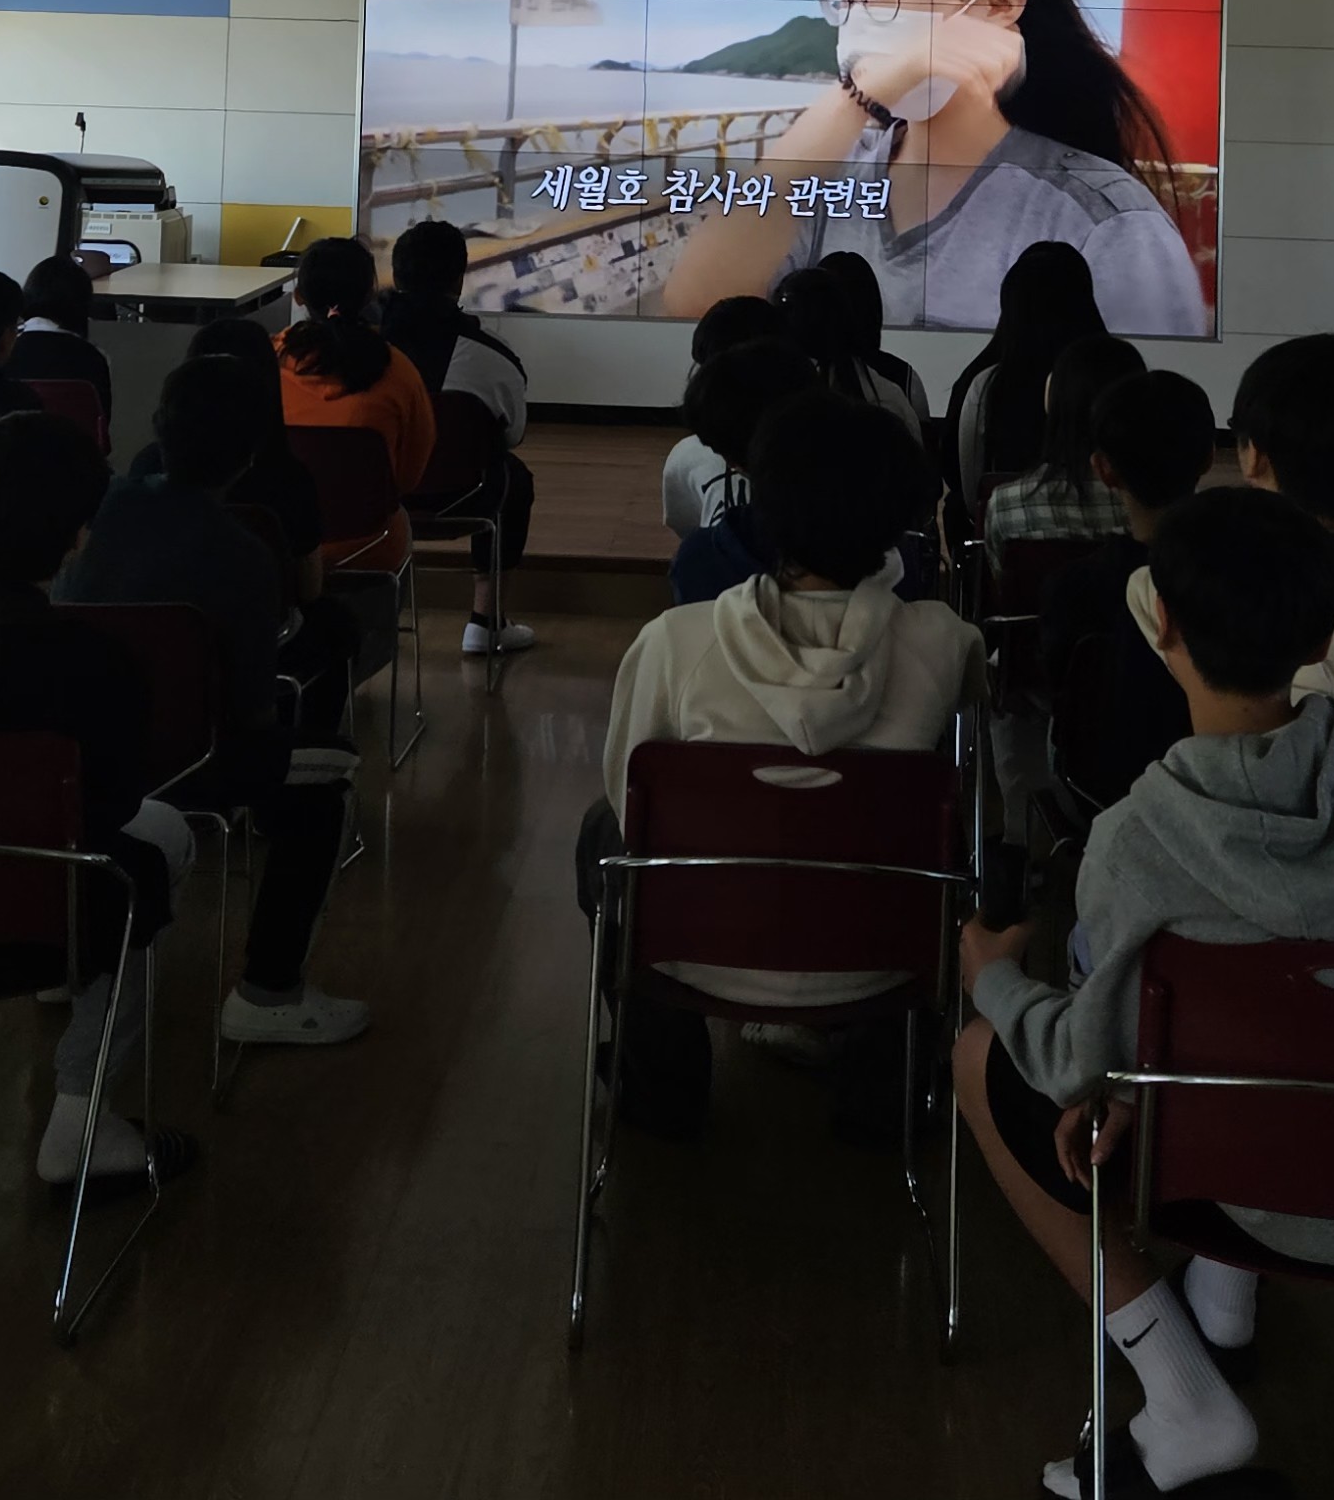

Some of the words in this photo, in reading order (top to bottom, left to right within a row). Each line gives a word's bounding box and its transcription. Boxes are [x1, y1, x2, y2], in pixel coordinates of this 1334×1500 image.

[531, 164, 649, 212] 세월호
[661, 169, 776, 216] 참사와
[784, 175, 892, 220] 관련된
